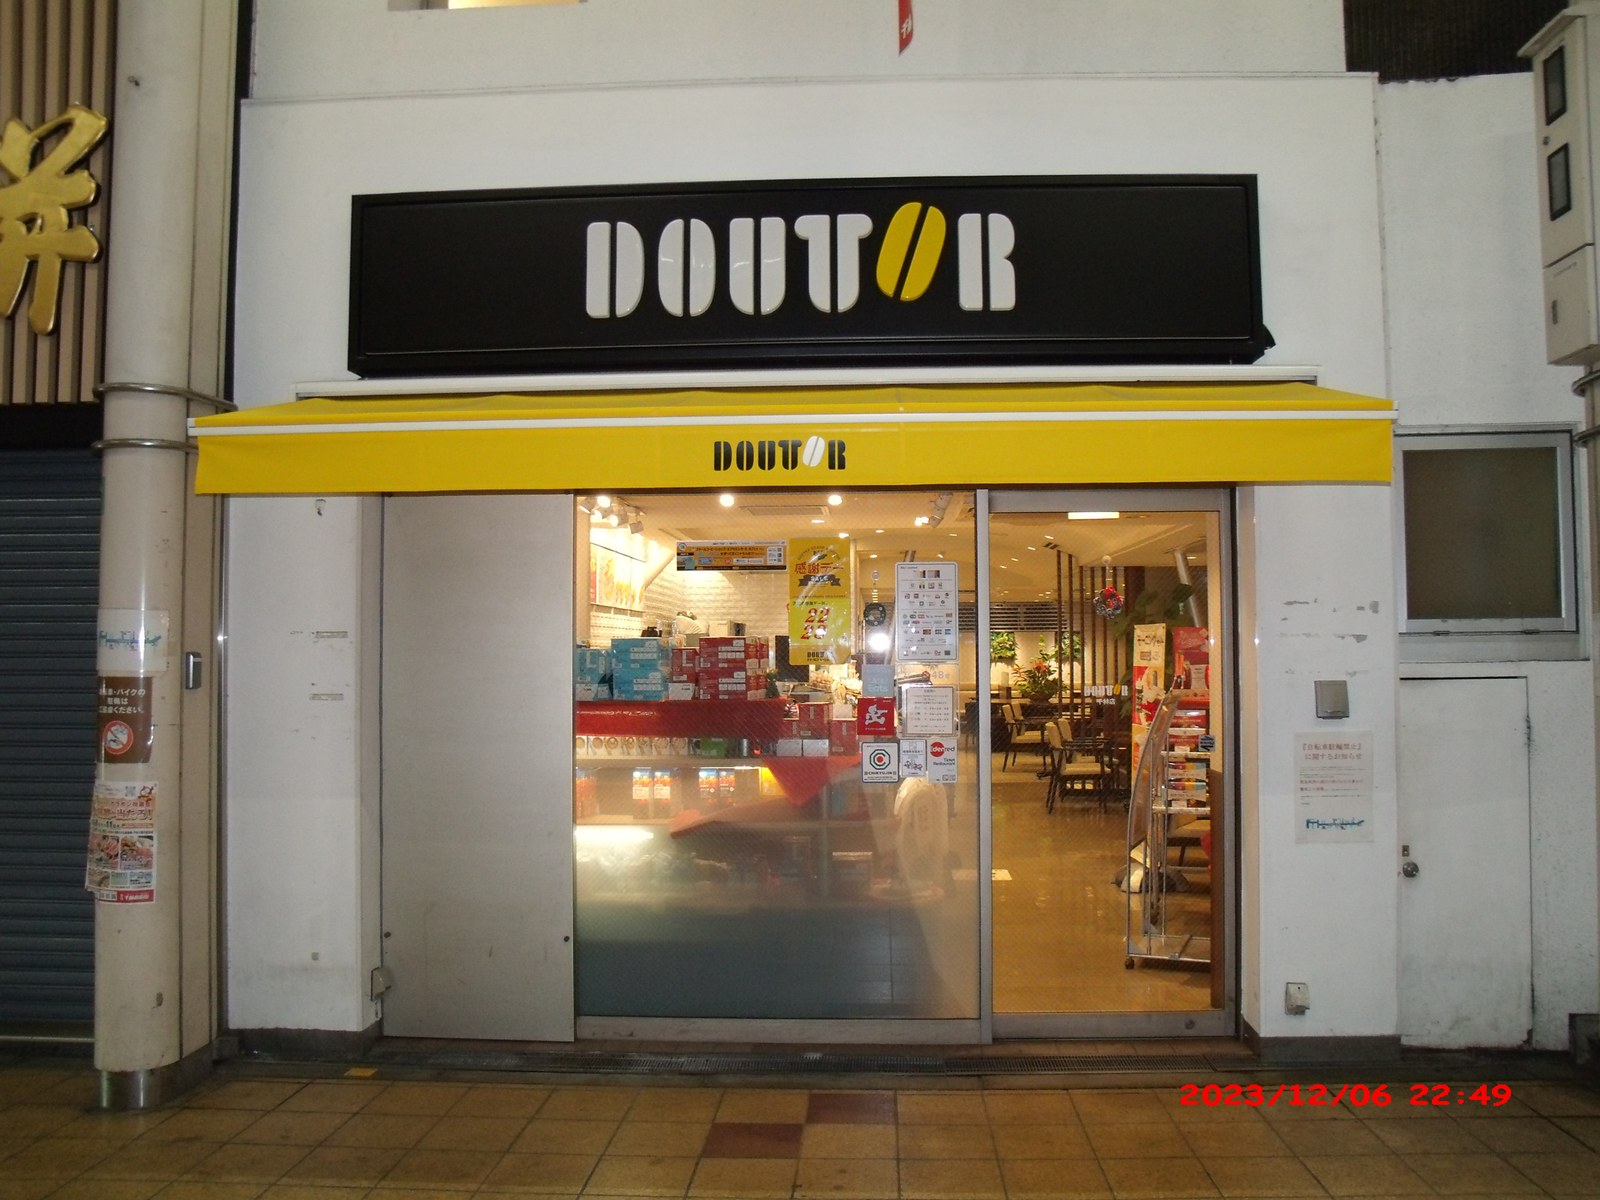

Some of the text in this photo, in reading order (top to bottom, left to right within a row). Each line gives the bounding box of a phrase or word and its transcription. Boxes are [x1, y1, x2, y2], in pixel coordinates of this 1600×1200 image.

[586, 201, 1016, 318] DOUTOR
[713, 435, 846, 471] DOUTOR
[795, 561, 844, 575] 感謝デー
[1083, 684, 1129, 696] DOUTOR
